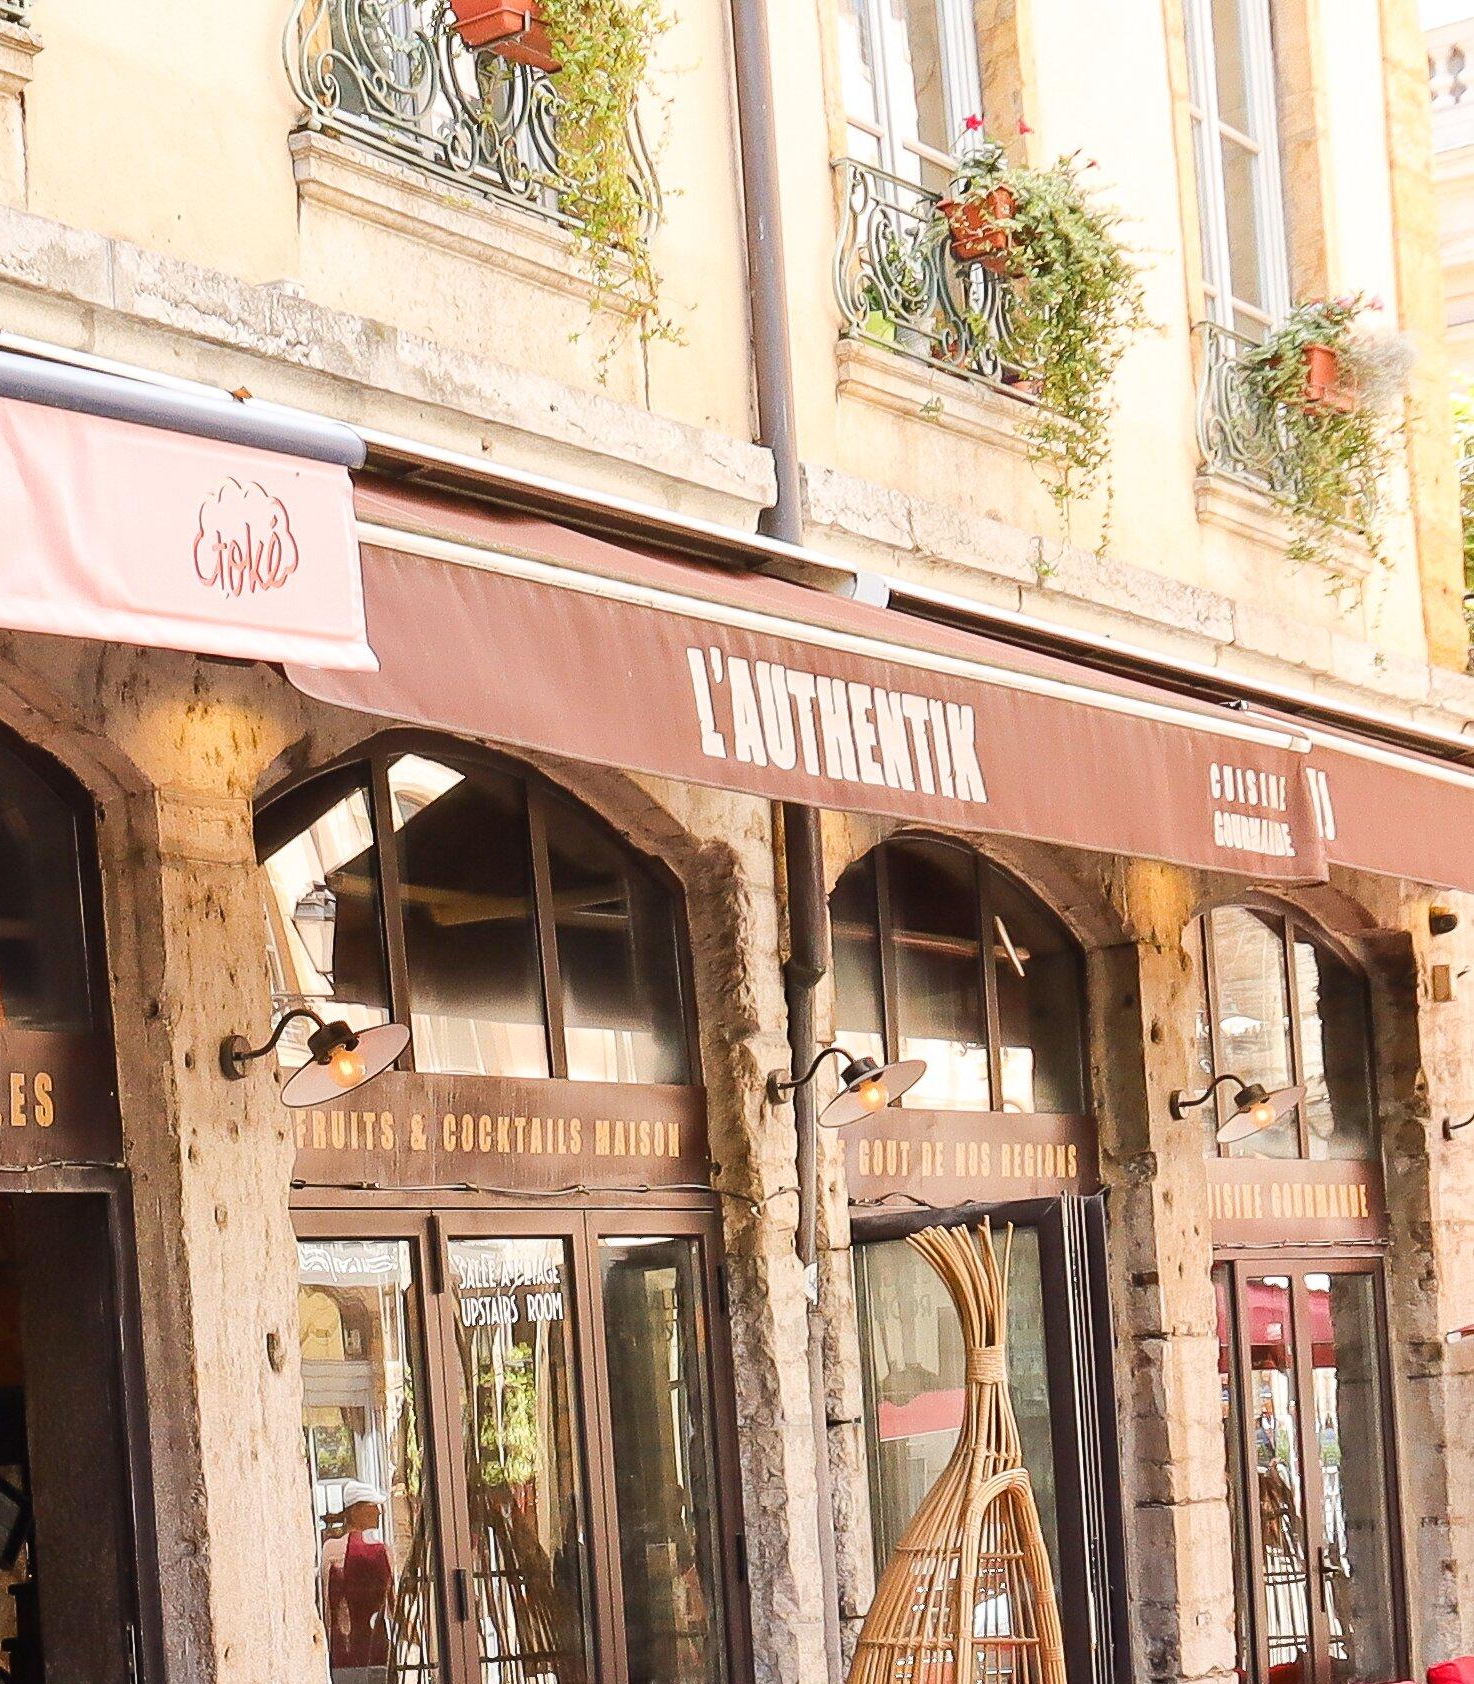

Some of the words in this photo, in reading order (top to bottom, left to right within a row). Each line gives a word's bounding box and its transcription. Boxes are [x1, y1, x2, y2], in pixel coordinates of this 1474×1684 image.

[686, 647, 988, 803] L'AUTHENTIK
[295, 1110, 395, 1151] FRUITS
[410, 1114, 427, 1151] &
[442, 1113, 582, 1155] COCKTAILS
[595, 1120, 681, 1158] MAISON
[858, 1139, 911, 1176] GOUT
[921, 1141, 944, 1177] DE
[955, 1142, 991, 1177] NOS
[1001, 1144, 1078, 1178] REGIONS
[460, 1295, 519, 1327] UPSTAIRS
[526, 1292, 564, 1322] ROOM
